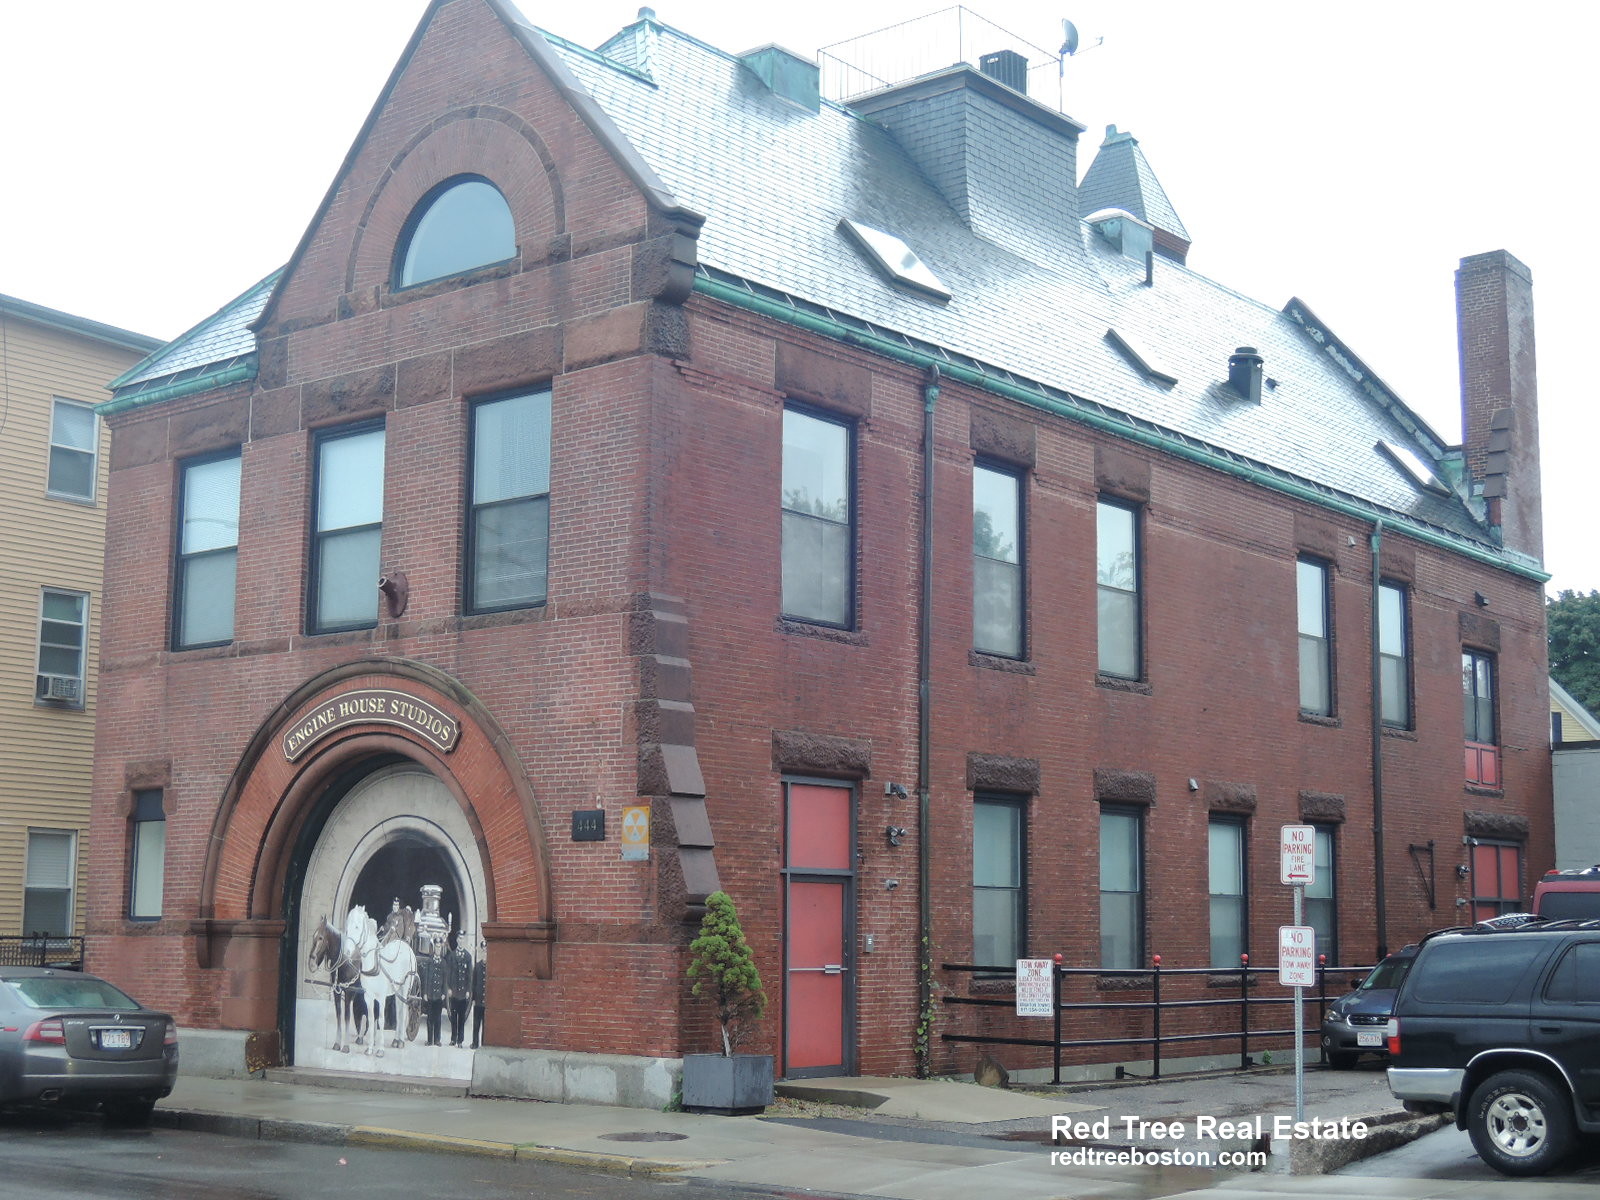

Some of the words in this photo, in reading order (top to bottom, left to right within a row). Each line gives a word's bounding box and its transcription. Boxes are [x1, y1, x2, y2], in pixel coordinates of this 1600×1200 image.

[287, 707, 337, 752] ENGINE
[339, 697, 386, 718] HOUSE
[390, 699, 451, 741] STUDIOS
[577, 818, 597, 831] 444
[1292, 831, 1304, 842] NO
[1284, 843, 1312, 854] PARKING
[1291, 855, 1305, 863] FIRE
[1290, 864, 1305, 872] LANE
[1281, 946, 1312, 958] PARKING
[1021, 960, 1032, 968] TOW
[1283, 960, 1295, 968] TOW
[1027, 968, 1041, 977] ZONE
[1289, 972, 1305, 980] ZONE
